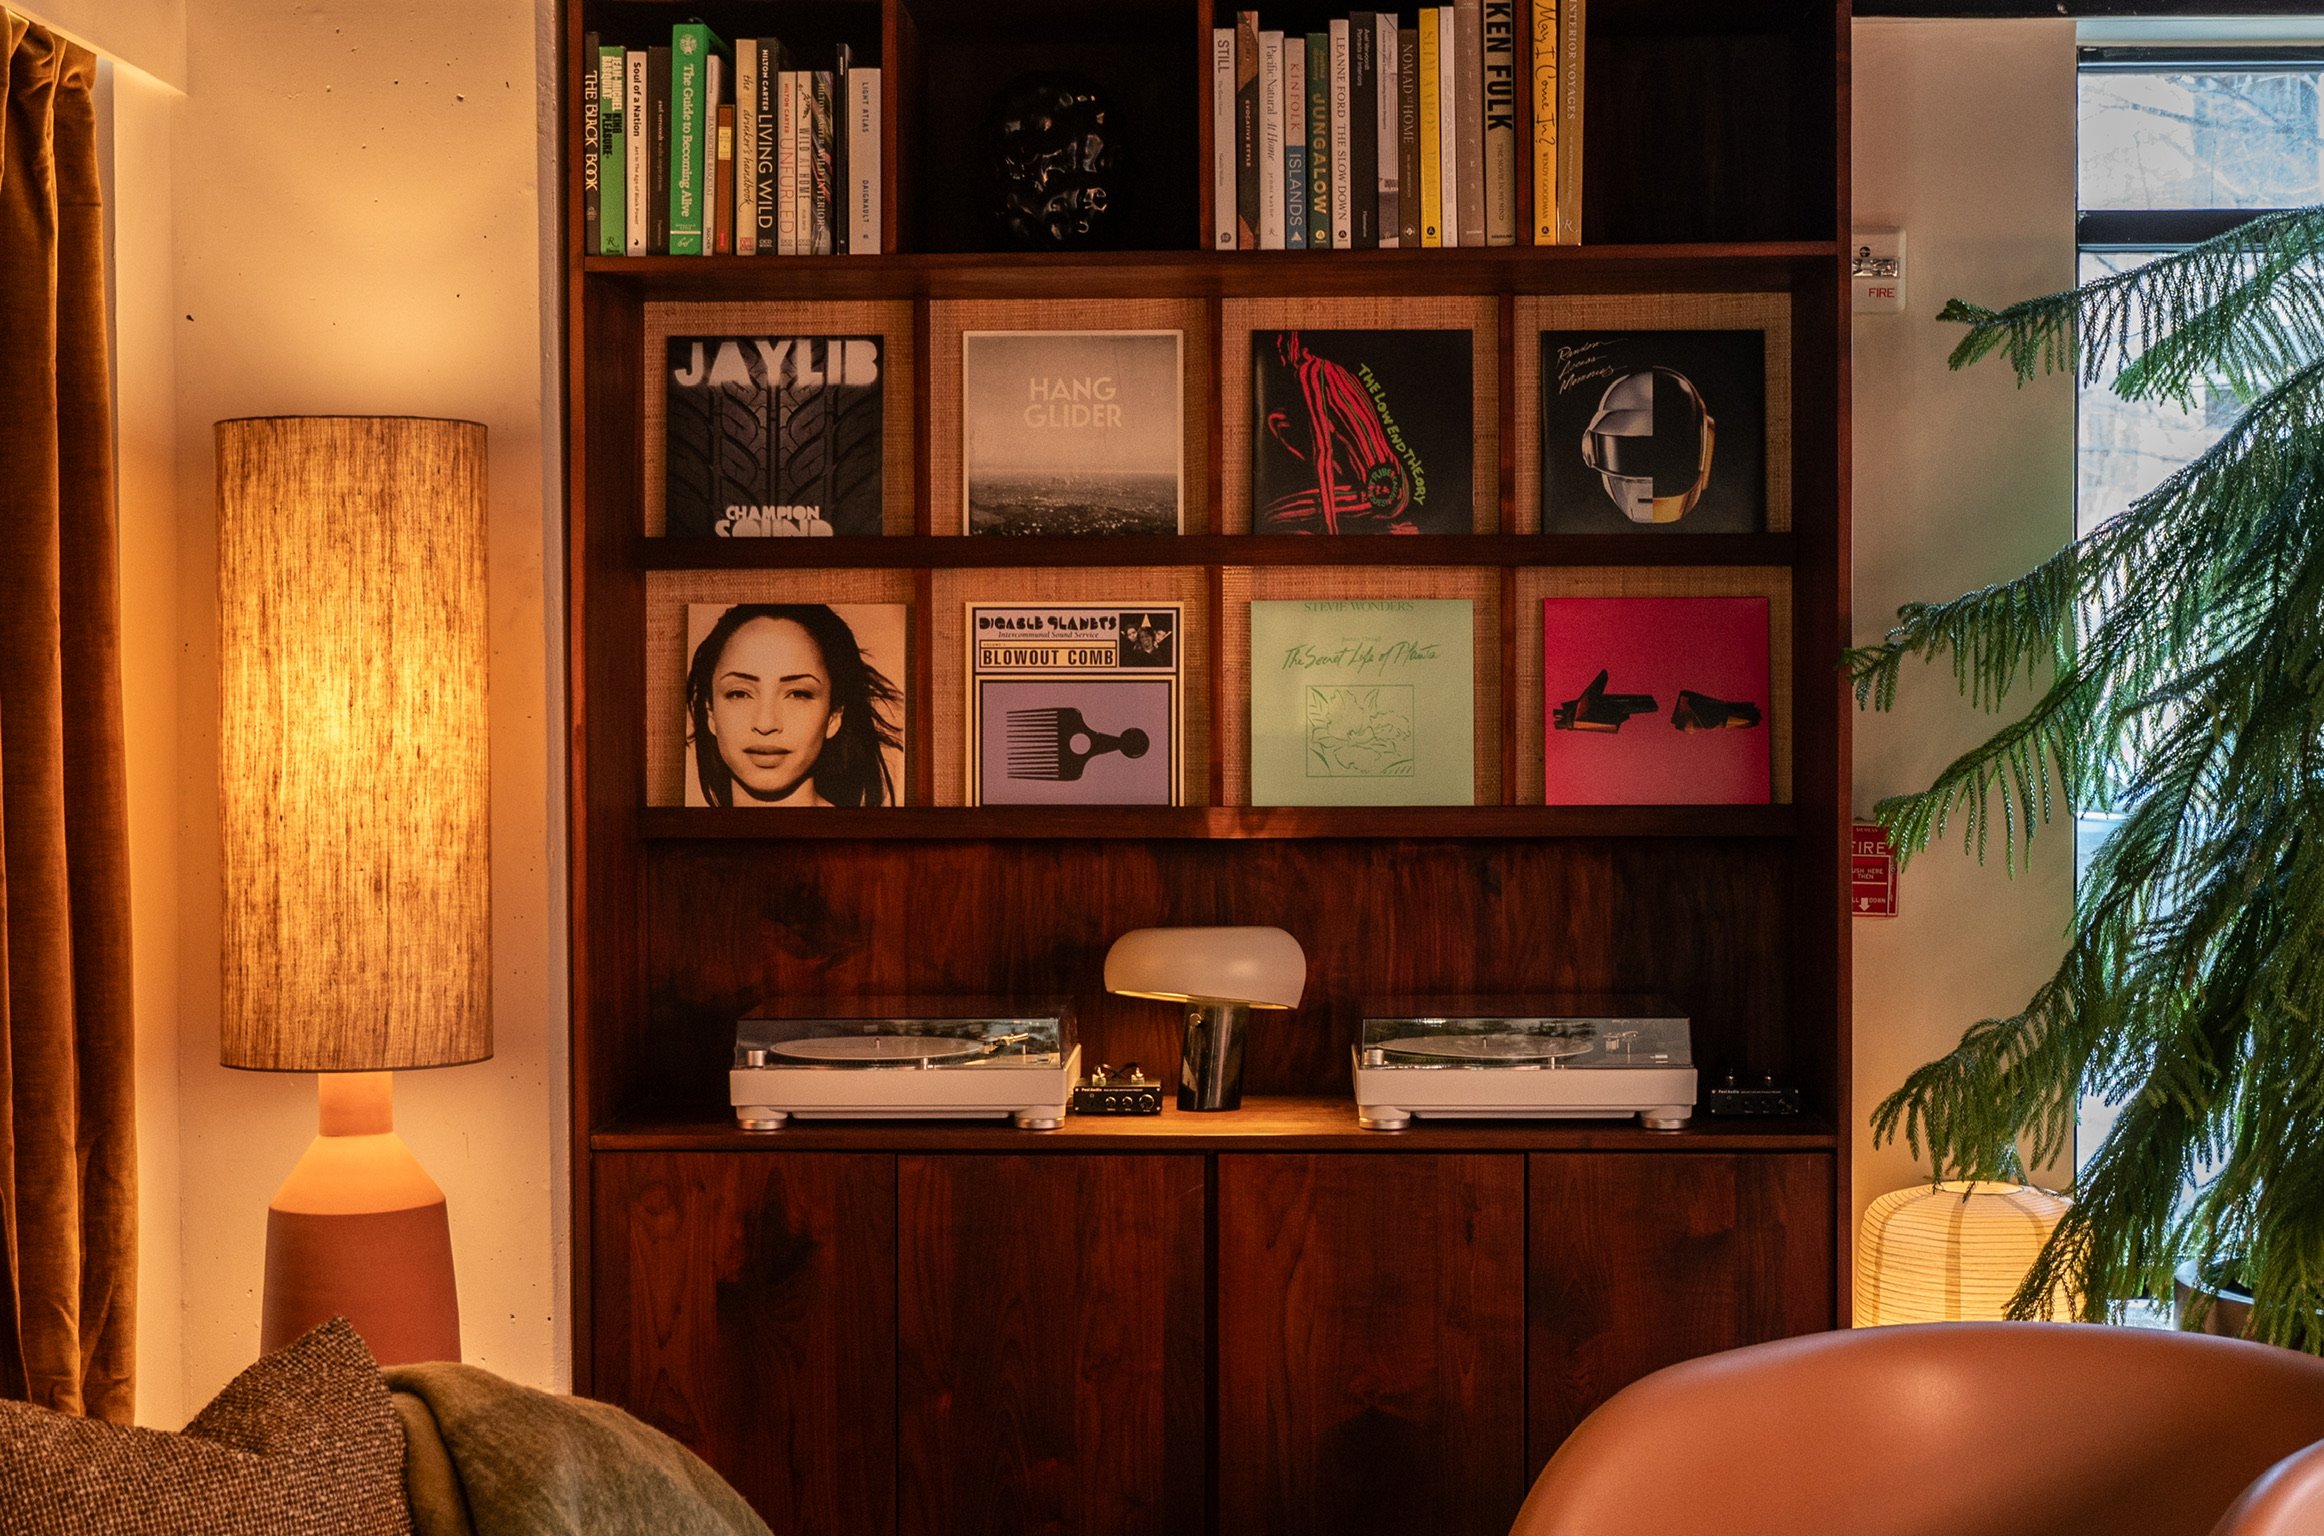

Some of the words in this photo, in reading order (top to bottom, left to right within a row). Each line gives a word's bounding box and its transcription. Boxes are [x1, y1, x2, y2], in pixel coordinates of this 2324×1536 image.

[1486, 2, 1511, 53] KEN
[1534, 2, 1556, 44] May
[1568, 0, 1577, 59] INTERIOR
[1217, 39, 1230, 73] STILL
[1266, 45, 1278, 77] Pacific
[1336, 37, 1346, 81] LEANNE
[1402, 43, 1413, 94] NOMAD
[1535, 46, 1556, 60] I
[585, 70, 598, 99] THE
[612, 56, 622, 111] JEAN-MICHEL
[633, 62, 642, 83] Soul
[683, 64, 695, 86] The
[743, 74, 753, 91] the
[1534, 64, 1557, 110] Come
[633, 85, 642, 95] of
[683, 87, 695, 119] Guide
[1266, 79, 1278, 115] Natural
[1290, 63, 1300, 131] KINFOLK
[1336, 86, 1346, 118] FORD
[1487, 65, 1513, 131] FULK
[1567, 63, 1577, 120] VOYAGES
[585, 104, 598, 148] BLACK
[613, 113, 622, 134] KING
[633, 105, 642, 137] Nation
[682, 121, 692, 133] to
[742, 109, 753, 155] drinker's
[1266, 118, 1278, 131] At
[1336, 123, 1346, 147] THE
[1402, 104, 1414, 144] HOME
[1535, 112, 1556, 146] In?
[758, 114, 773, 174] LIVING
[799, 127, 810, 152] WILD
[1266, 132, 1278, 161] Home
[1312, 93, 1327, 214] JUNGALOW
[585, 153, 598, 191] BOOK
[679, 134, 692, 188] Becoming
[799, 157, 810, 169] AT
[816, 147, 826, 176] WILD
[1336, 150, 1347, 182] SLOW
[1541, 152, 1549, 177] WENDY
[738, 157, 754, 212] handbook
[779, 138, 794, 234] UNFURLED
[799, 173, 810, 199] HOME
[1289, 154, 1302, 226] ISLANDS
[1541, 178, 1549, 219] GOODMAN
[681, 190, 692, 217] Alive
[758, 180, 773, 228] WILD
[816, 178, 826, 232] INTERIORS
[1337, 185, 1347, 221] DOWN
[1868, 287, 1895, 298] FIRE
[674, 339, 878, 387] JAYLIB
[1030, 377, 1117, 400] HANG
[1023, 404, 1122, 428] GLIDER
[1359, 363, 1381, 394] THE
[1374, 392, 1394, 425] LOW
[1387, 425, 1406, 453] END
[1403, 448, 1426, 506] THEORY
[725, 505, 820, 520] CHAMPION
[1047, 616, 1117, 631] PLANETS
[983, 650, 1059, 665] BLOWOUT
[1068, 650, 1114, 665] COMB
[1282, 644, 1307, 669] The
[1304, 646, 1354, 669] Secret
[1348, 642, 1374, 674] Life
[1378, 647, 1394, 676] of
